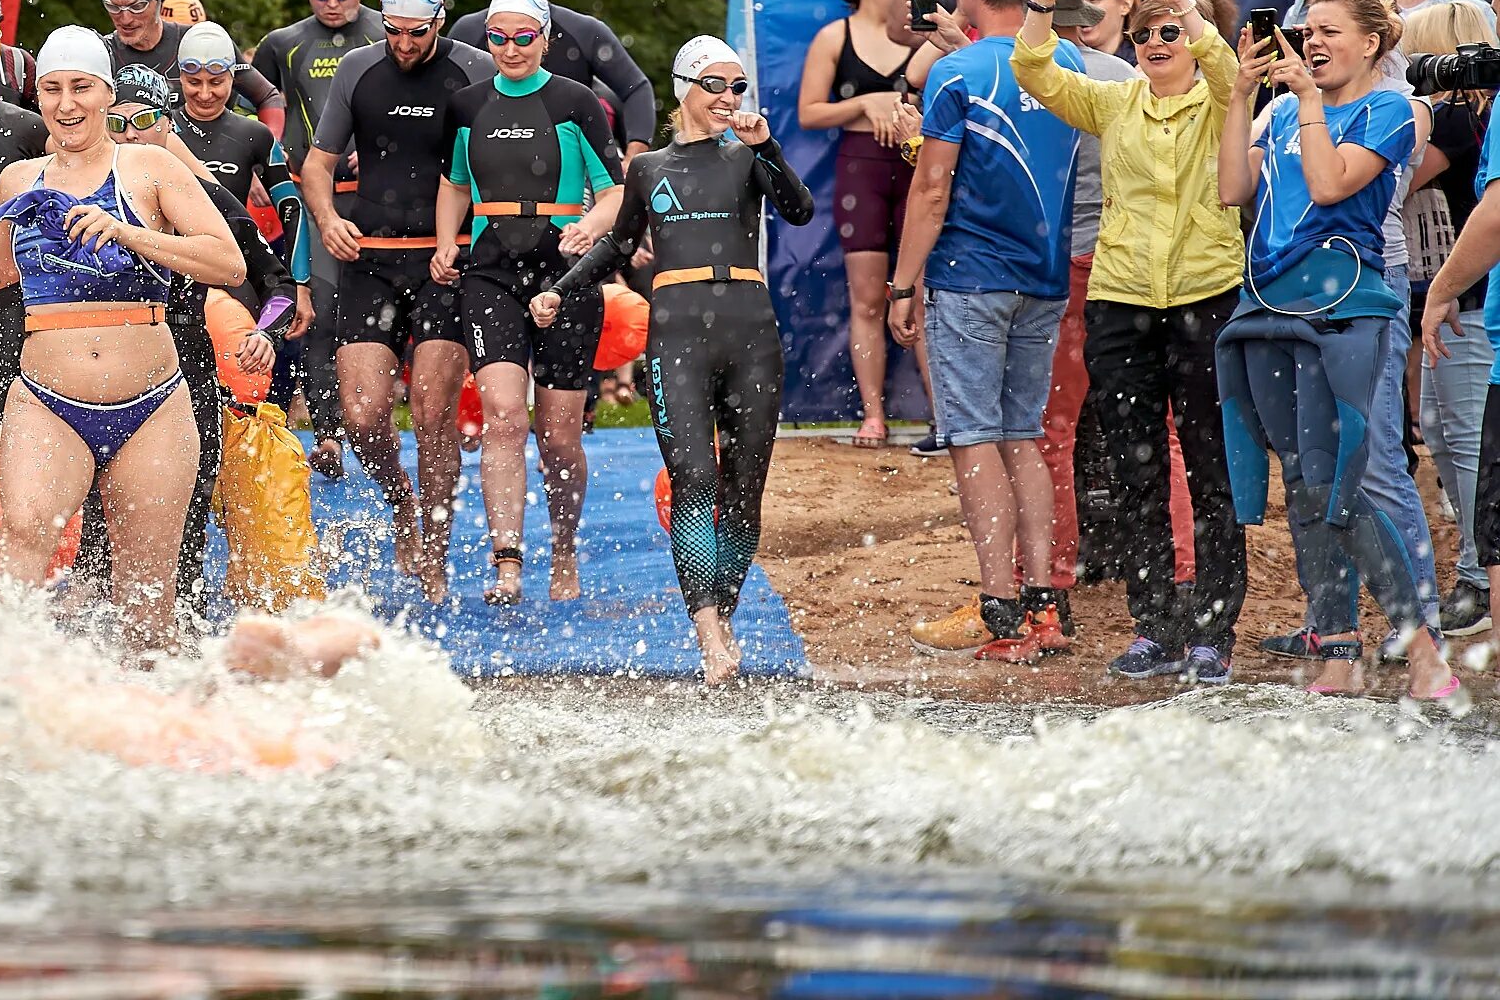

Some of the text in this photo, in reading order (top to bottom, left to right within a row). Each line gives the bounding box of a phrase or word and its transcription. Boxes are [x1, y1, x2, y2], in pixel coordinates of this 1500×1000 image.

[387, 105, 435, 118] JOSS
[486, 128, 536, 139] JOSS
[663, 211, 732, 223] Aqua Sphere
[471, 322, 486, 358] JOSS
[651, 357, 668, 425] RACER
